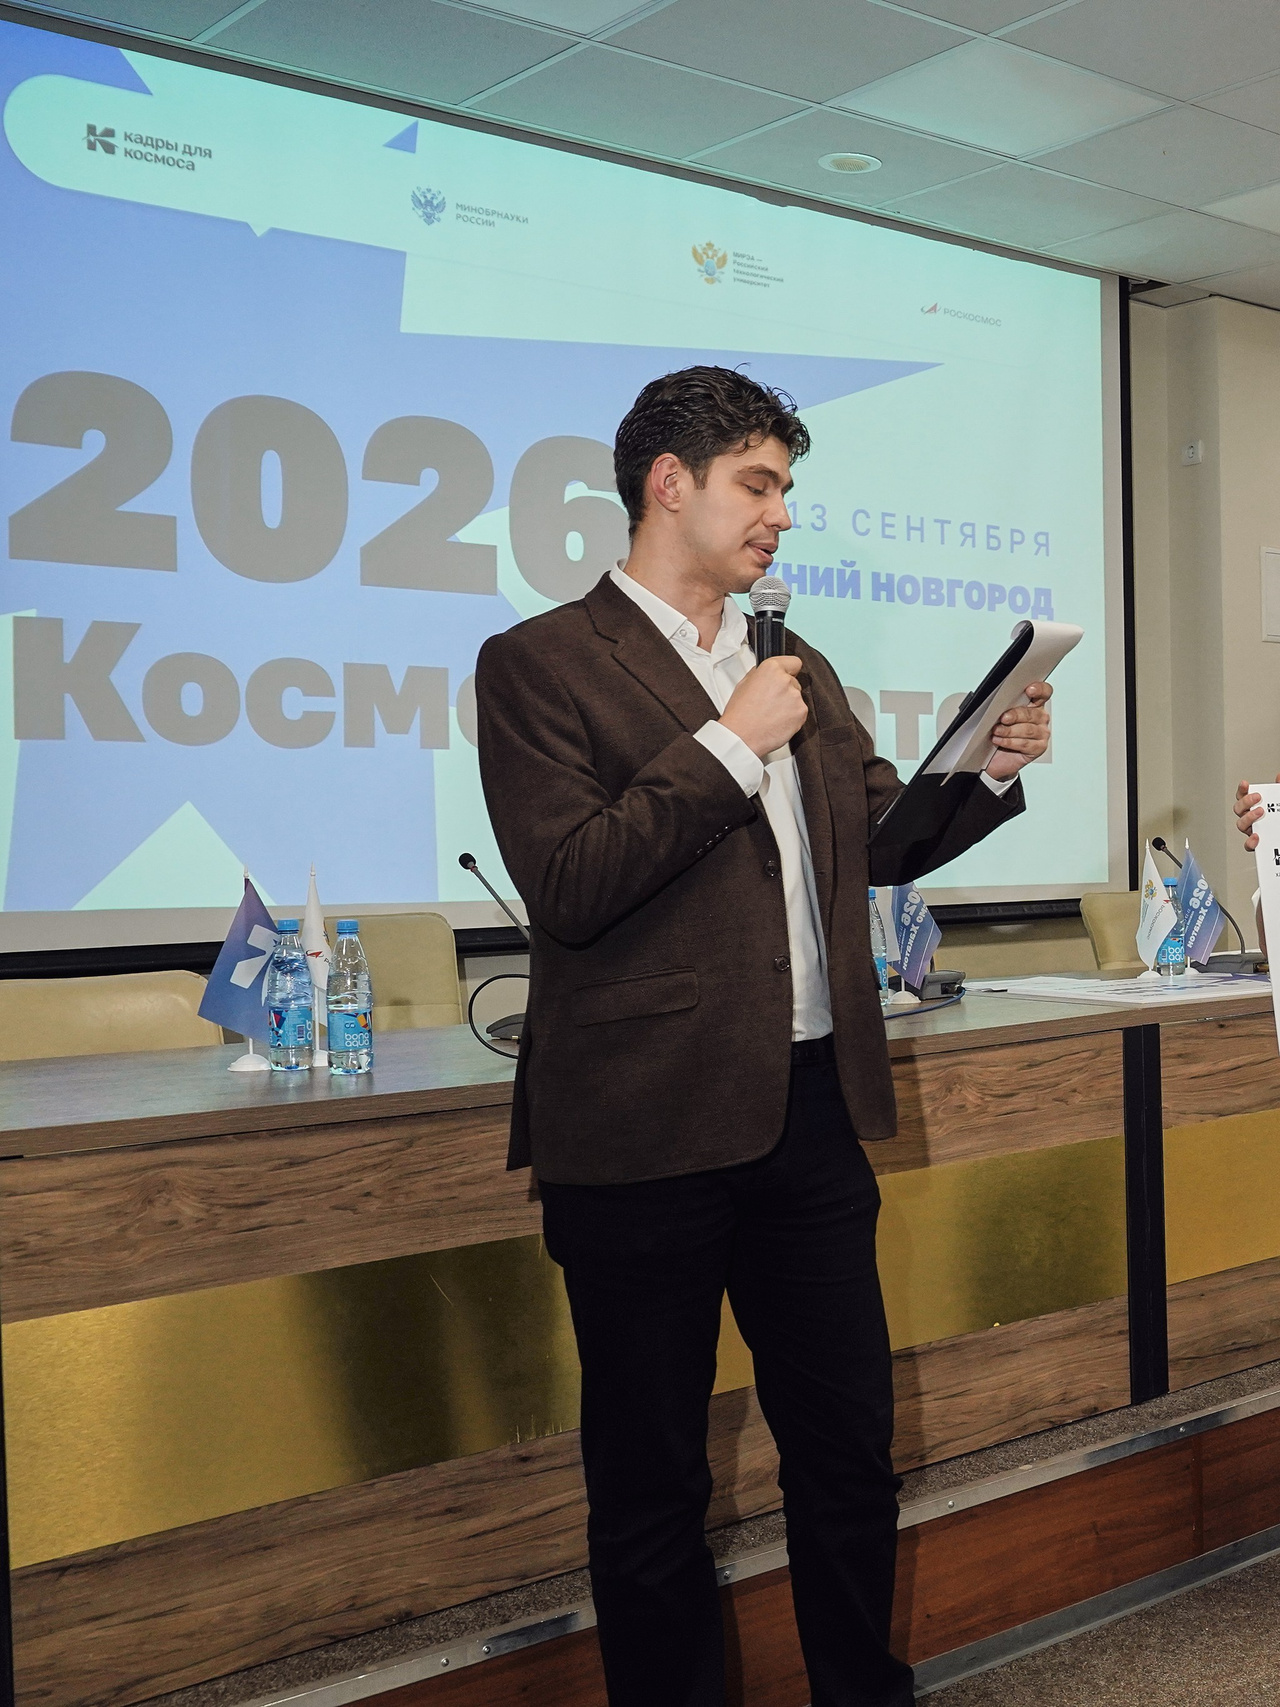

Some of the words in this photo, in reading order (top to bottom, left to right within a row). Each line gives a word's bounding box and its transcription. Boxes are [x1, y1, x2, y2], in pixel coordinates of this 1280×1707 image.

[124, 131, 178, 152] кадры
[181, 143, 212, 159] для
[124, 147, 195, 171] космоса
[455, 202, 529, 224] МИНОБРНАУКИ
[455, 213, 496, 228] РОССИИ
[943, 307, 1002, 327] РОСКОСМОС
[8, 370, 630, 604] 2026
[852, 508, 1050, 557] СЕНТЯБРЯ
[871, 571, 1054, 621] НОВГОРОД
[12, 616, 479, 750] Косм
